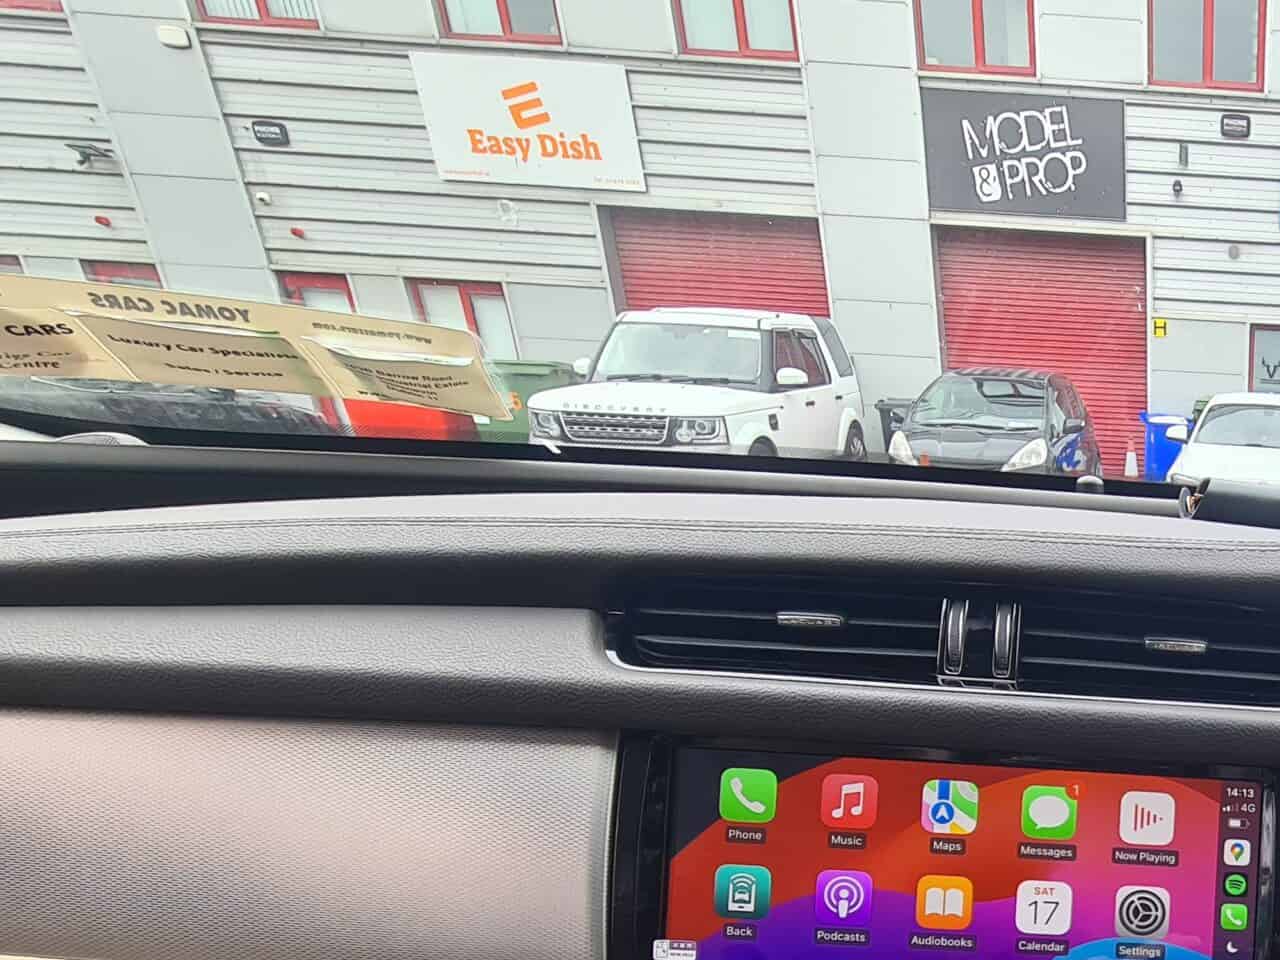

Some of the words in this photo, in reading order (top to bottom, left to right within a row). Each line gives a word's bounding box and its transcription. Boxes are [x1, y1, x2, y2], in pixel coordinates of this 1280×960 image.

[961, 105, 1083, 160] MODEL
[467, 129, 531, 163] Easy
[536, 132, 603, 161] Dish
[1002, 151, 1087, 200] PROP
[4, 323, 75, 337] CARS
[1153, 321, 1168, 335] H
[107, 334, 172, 352] Luxury
[175, 343, 204, 353] Car
[563, 402, 667, 413] DISCOVERY
[1226, 787, 1255, 799] 14:13
[1240, 803, 1256, 813] 4G
[727, 829, 763, 841] Phone
[831, 834, 863, 847] Music
[932, 840, 963, 853] Maps
[1020, 845, 1073, 858] Messages
[1115, 851, 1137, 862] Now
[1139, 853, 1176, 865] Playing
[1033, 886, 1056, 897] SAT
[1027, 900, 1061, 927] 17
[726, 925, 753, 937] Back
[816, 930, 866, 943] Podcasts
[911, 935, 973, 948] Audiobooks
[1018, 940, 1065, 953] Calendar
[1118, 945, 1161, 958] Settings
